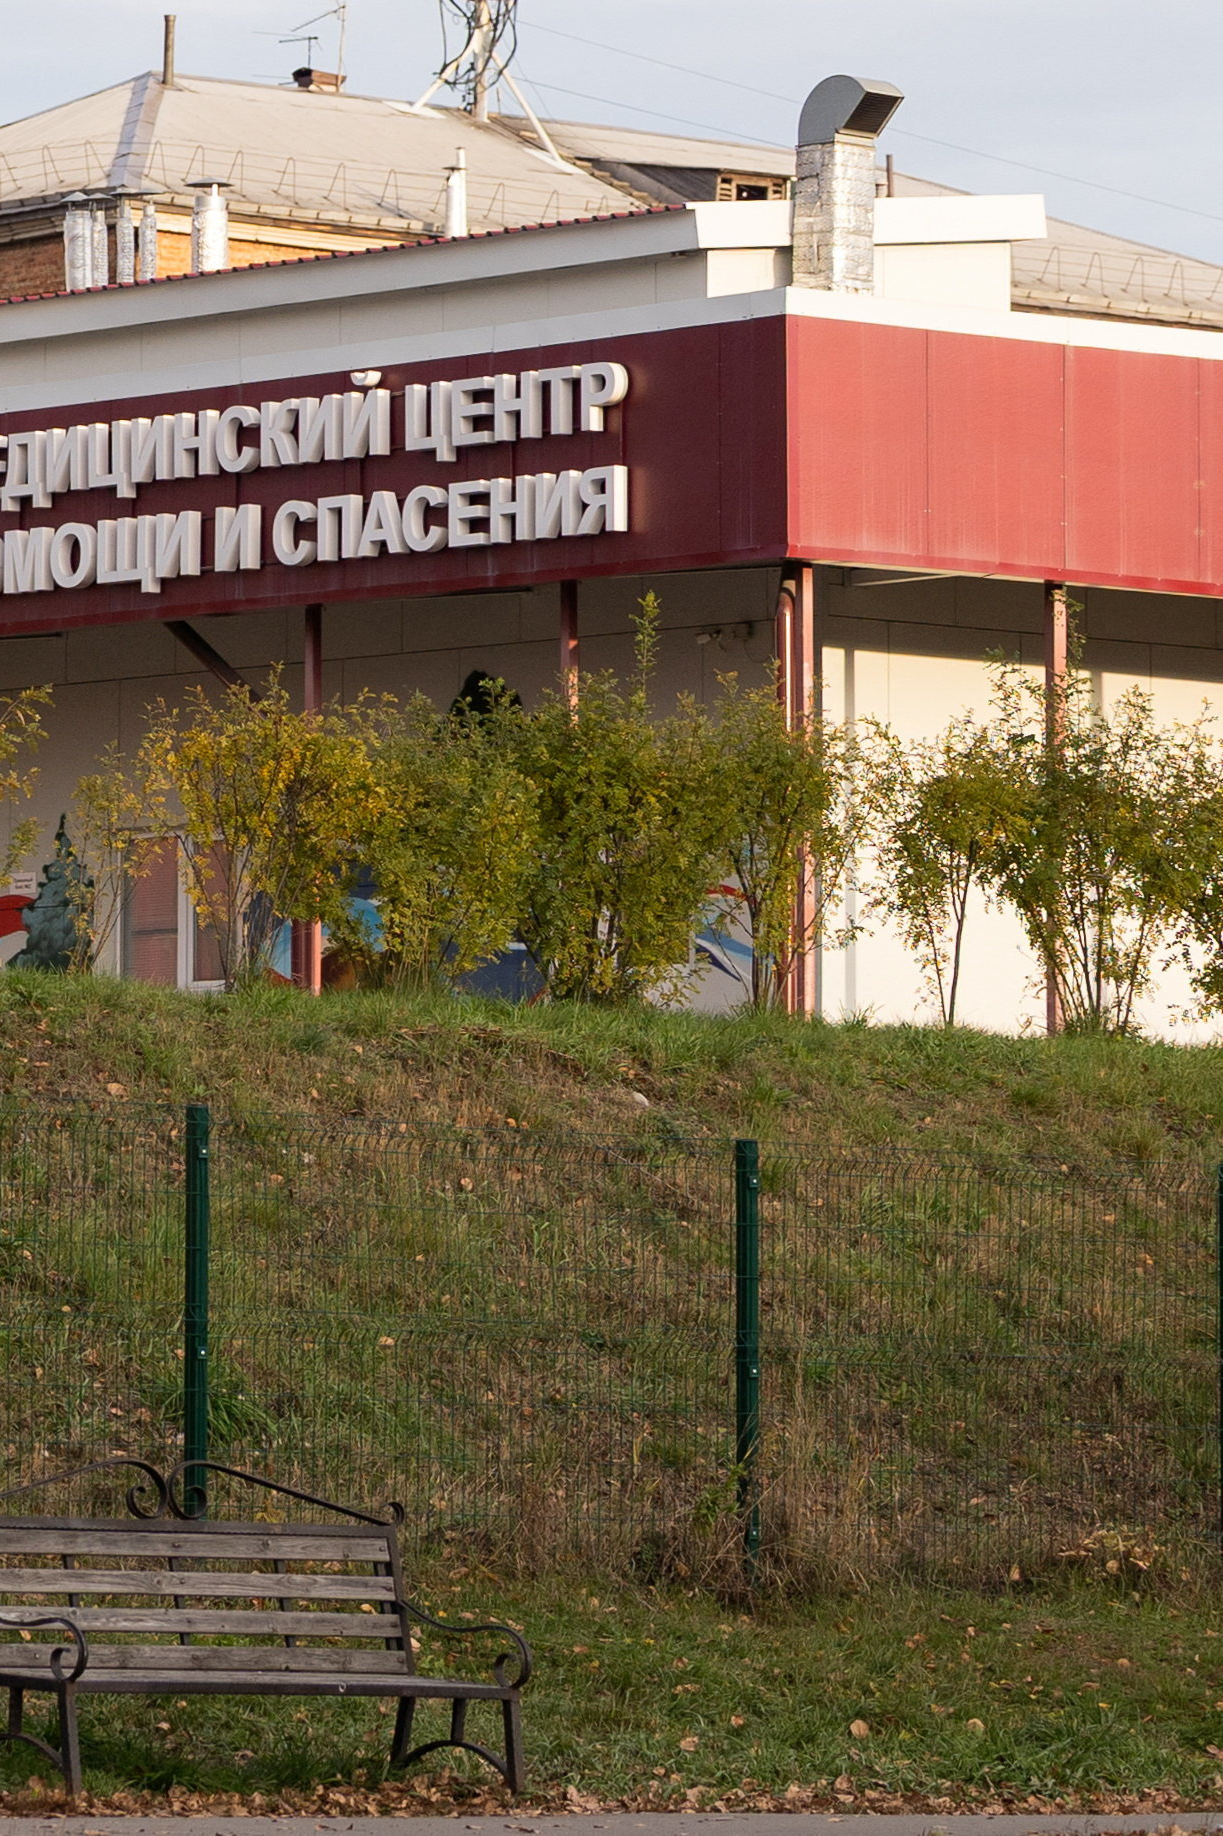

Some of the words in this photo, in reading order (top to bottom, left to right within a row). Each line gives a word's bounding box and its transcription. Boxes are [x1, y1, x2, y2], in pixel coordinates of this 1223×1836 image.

[404, 362, 629, 462] ЦЕНТР
[214, 503, 262, 573] И
[272, 464, 629, 567] СПАСЕНИЯ
